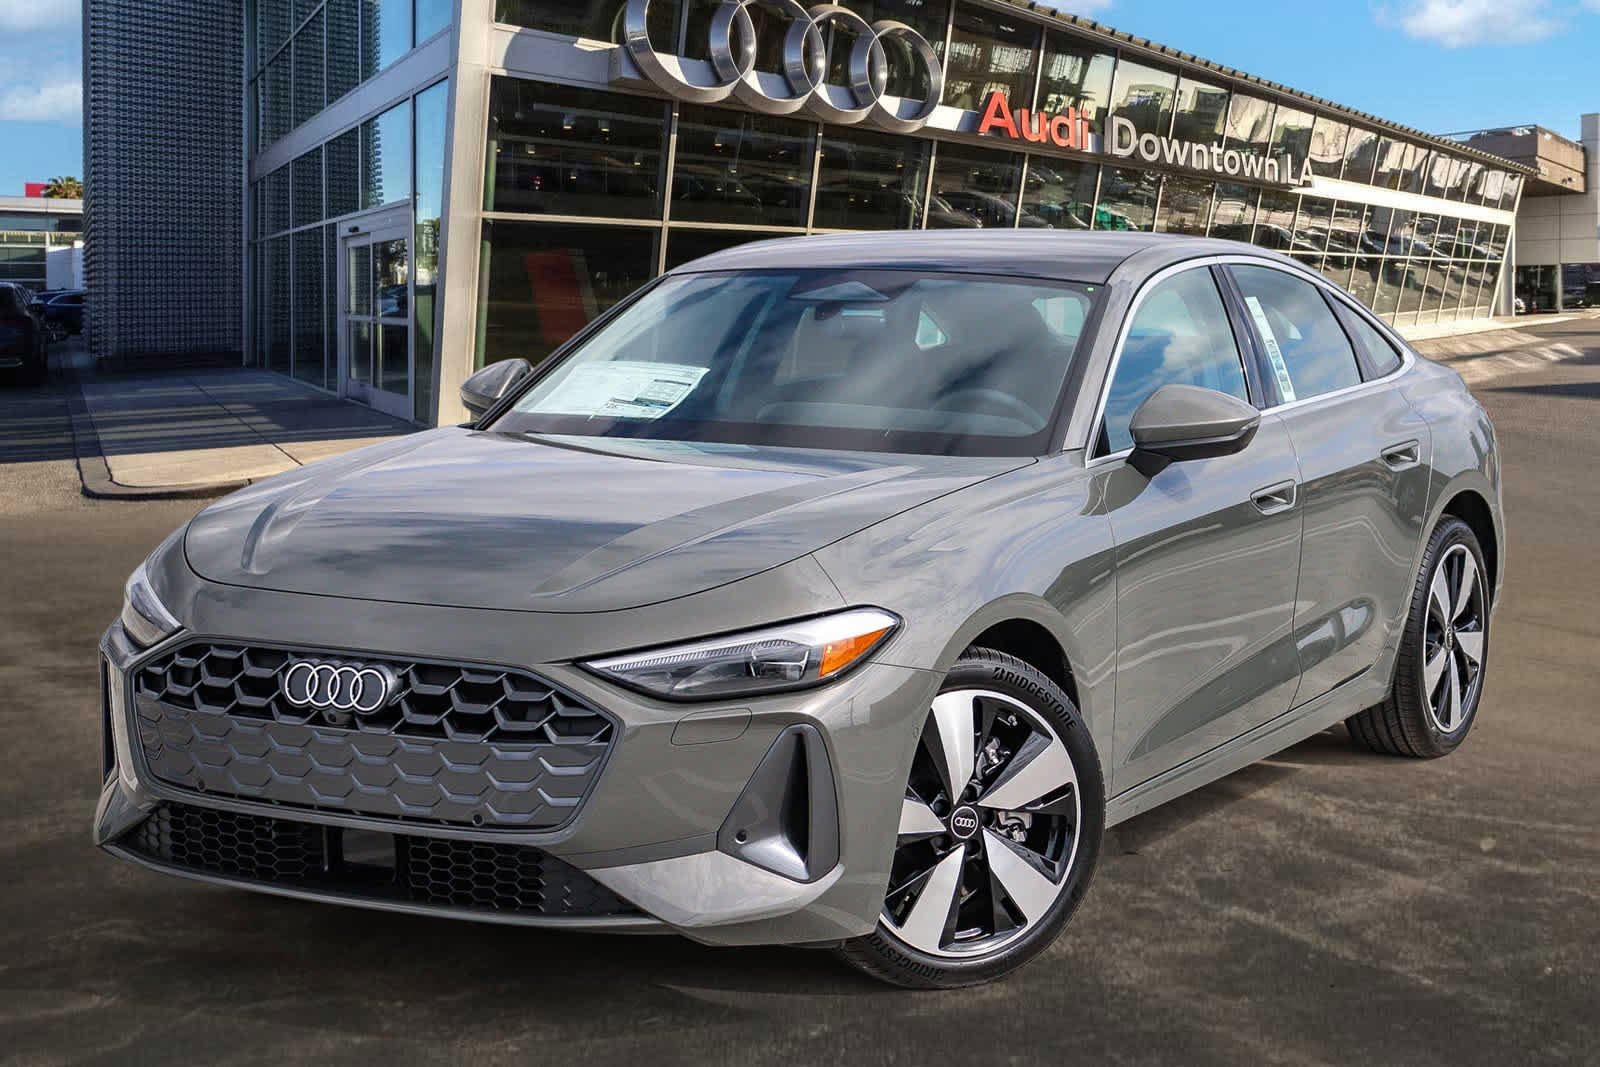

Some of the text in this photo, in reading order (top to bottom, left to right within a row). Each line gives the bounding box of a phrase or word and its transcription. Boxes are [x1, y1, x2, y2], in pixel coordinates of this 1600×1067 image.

[978, 91, 1316, 188] Audi Downtown LA
[993, 667, 1077, 730] BRIDGESTONE
[865, 932, 946, 981] BRIDGESTO
